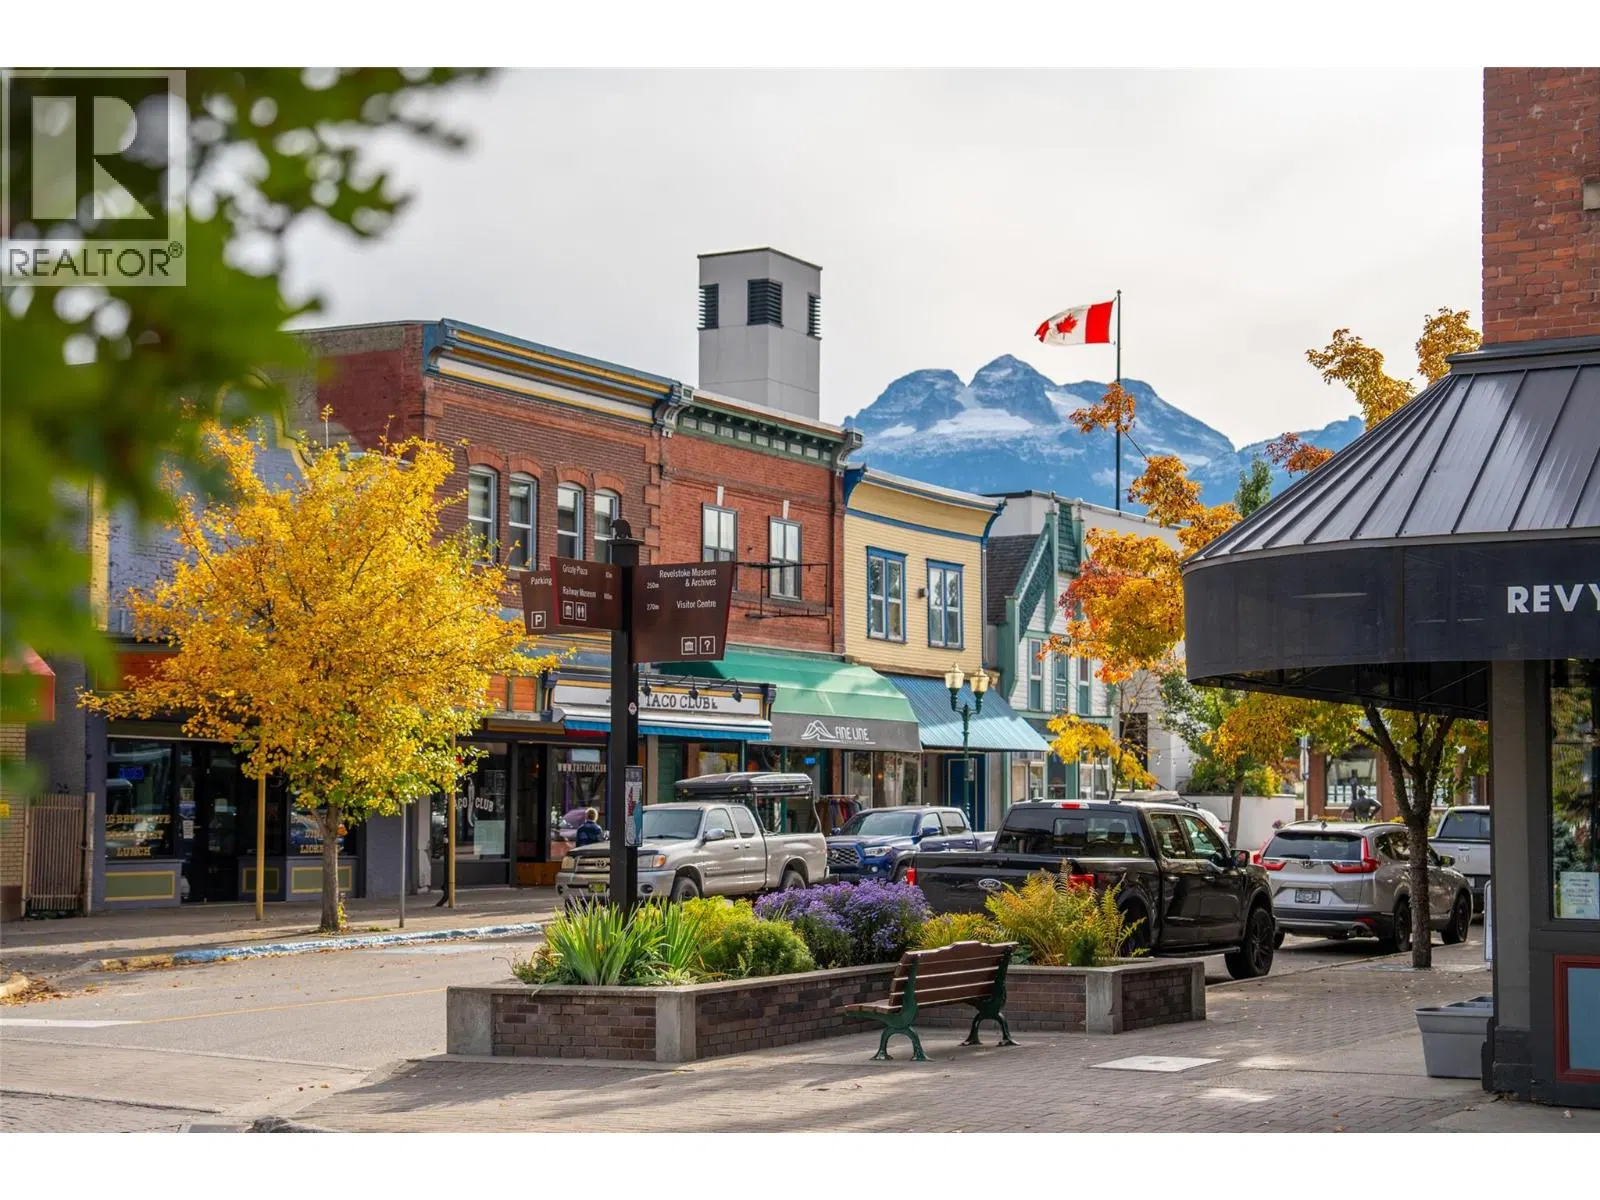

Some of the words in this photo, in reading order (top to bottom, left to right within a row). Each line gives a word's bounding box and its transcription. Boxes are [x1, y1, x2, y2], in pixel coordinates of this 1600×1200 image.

[577, 566, 588, 576] Plaza
[660, 569, 691, 578] Revelstoke
[691, 568, 717, 577] Museum
[530, 576, 553, 586] Parking
[685, 579, 690, 587] &
[691, 578, 717, 586] Archives
[562, 586, 579, 597] Railway
[579, 588, 597, 598] Museum
[646, 603, 660, 611] 270m
[676, 600, 696, 608] Visitor
[696, 600, 717, 608] Centre
[645, 693, 677, 708] TACO
[835, 726, 852, 740] FINE
[475, 797, 494, 812] CLUB
[116, 846, 152, 857] LUNCH
